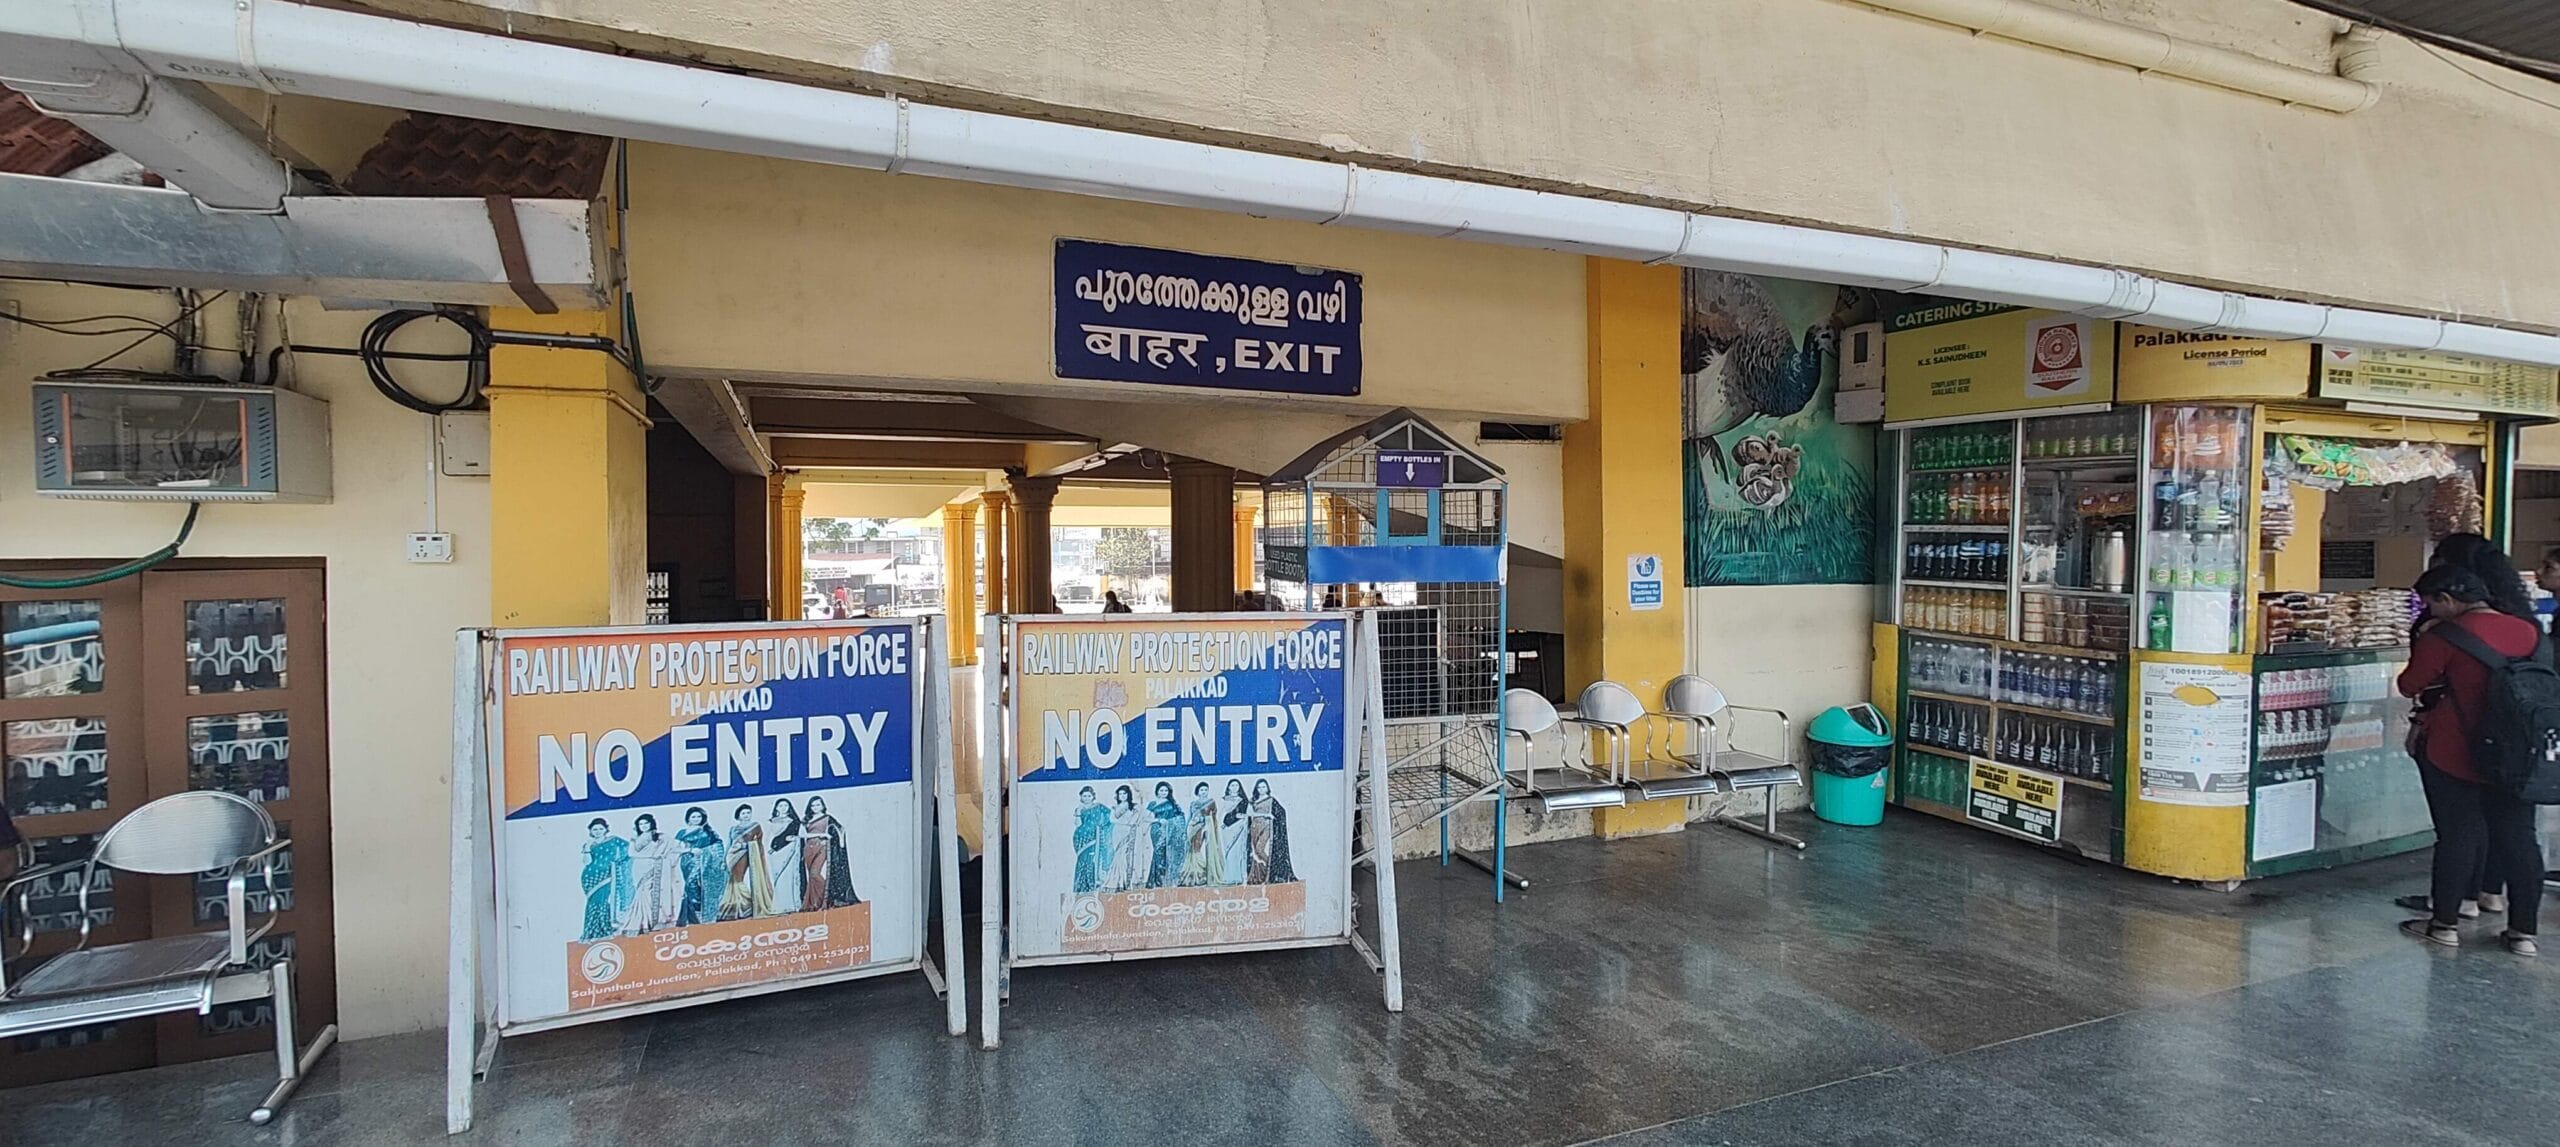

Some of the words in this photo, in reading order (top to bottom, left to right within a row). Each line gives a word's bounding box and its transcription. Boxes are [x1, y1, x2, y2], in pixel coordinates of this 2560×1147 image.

[1075, 269, 1289, 328] പുറത്തേക്കുള്ള
[1297, 279, 1346, 323] വഴി
[1895, 301, 1972, 328] CATERING
[1080, 324, 1208, 369] बाहर
[2184, 349, 2229, 360] License
[2231, 347, 2267, 358] Period
[1380, 455, 1402, 463] EMPTY
[1264, 558, 1284, 574] BOTTLE
[1285, 562, 1305, 578] BOOTH
[509, 644, 640, 695] RAILWAY
[650, 637, 819, 687] PROTECTION
[827, 633, 906, 676] FORCE
[1022, 632, 1123, 674] RAILWAY
[1130, 630, 1268, 672] PROTECTION
[1274, 630, 1342, 670] FORCE
[670, 687, 773, 717] PALAKKAD
[1145, 676, 1228, 700] PALAKKAD
[1043, 709, 1124, 770] NO
[1145, 704, 1325, 767] ENTRY
[538, 729, 644, 803] NO
[670, 711, 889, 792] ENTRY
[1975, 769, 2009, 785] AVAILABLE
[1983, 780, 2000, 792] HERE
[2016, 779, 2054, 797] AVAILABLE
[2025, 791, 2043, 804] HERE
[655, 923, 829, 962] ശകുന്തള
[571, 981, 643, 998] Sakunthala
[646, 972, 701, 987] Junction,
[705, 961, 762, 977] Palakkad,
[766, 958, 779, 968] Ph
[790, 944, 869, 964] 0491-2534021
